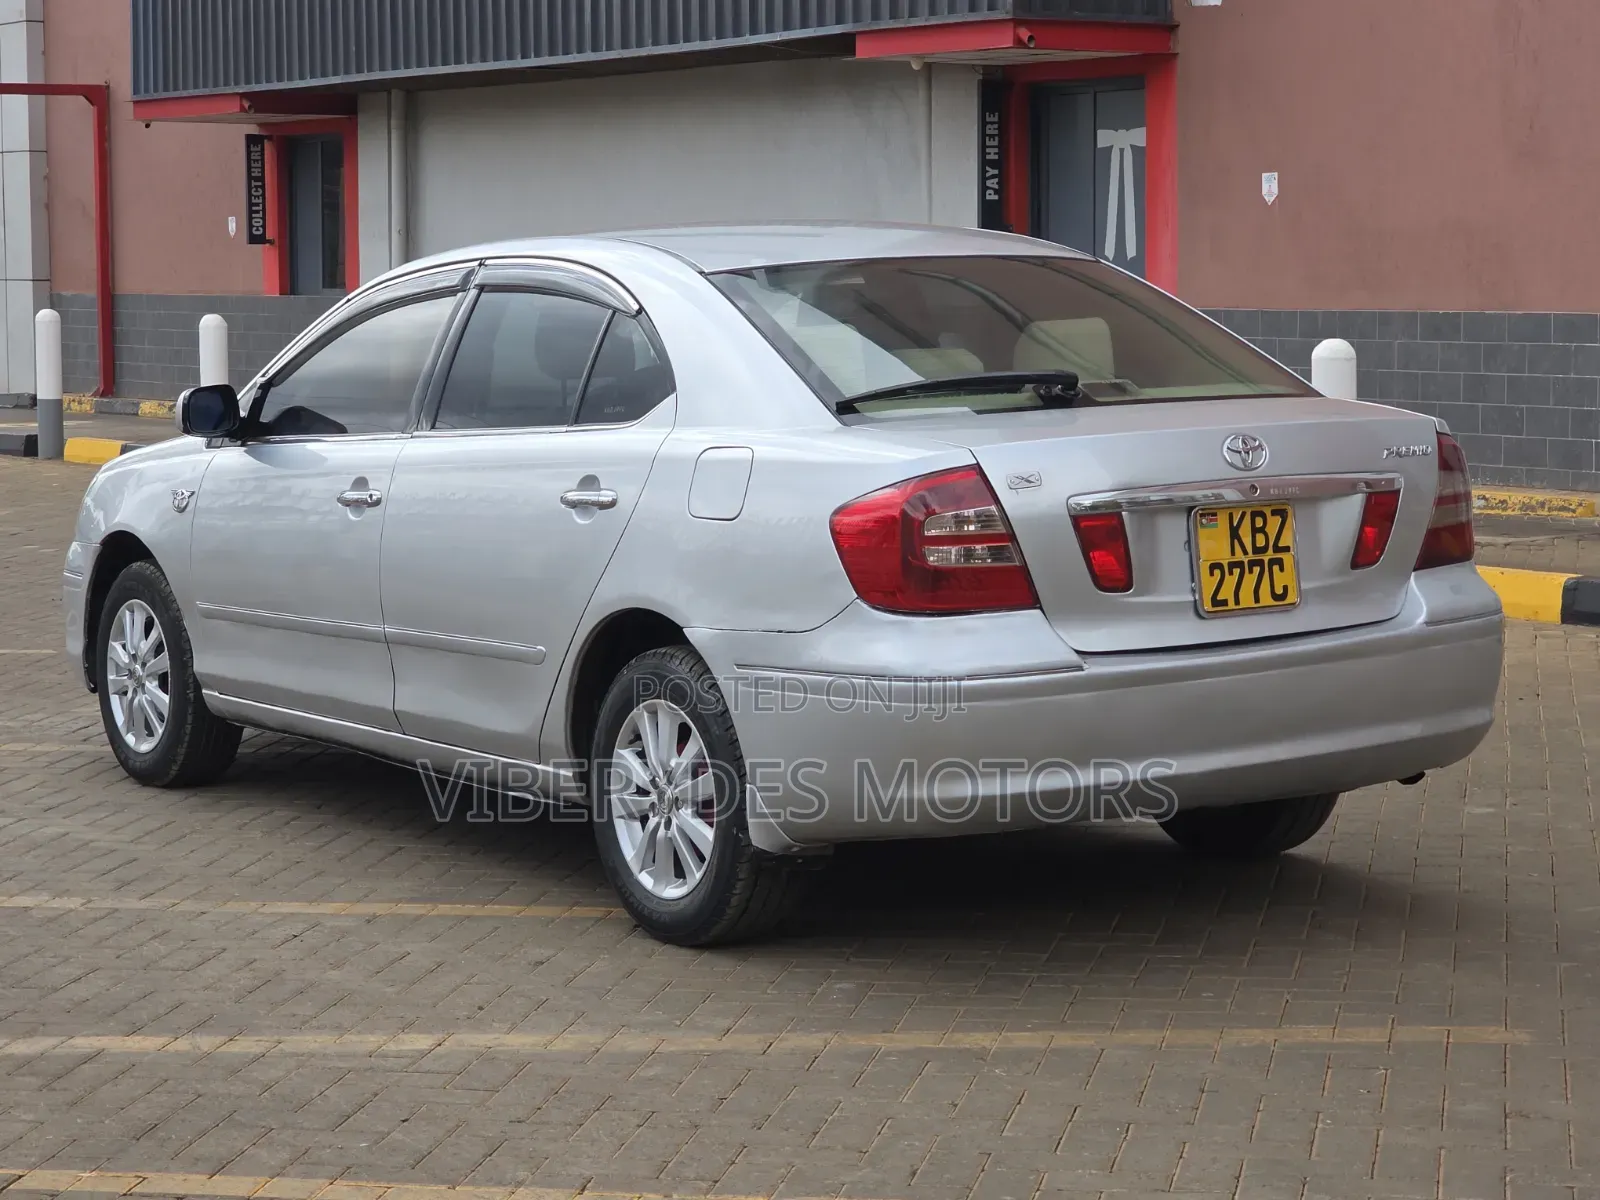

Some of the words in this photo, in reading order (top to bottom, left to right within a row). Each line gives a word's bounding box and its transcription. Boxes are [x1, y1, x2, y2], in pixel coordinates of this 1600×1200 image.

[985, 112, 999, 160] HERE
[250, 144, 262, 177] HERE
[985, 166, 999, 200] PAY
[251, 180, 264, 235] COLLECT
[1228, 508, 1291, 557] KBZ
[1208, 557, 1289, 608] 277C
